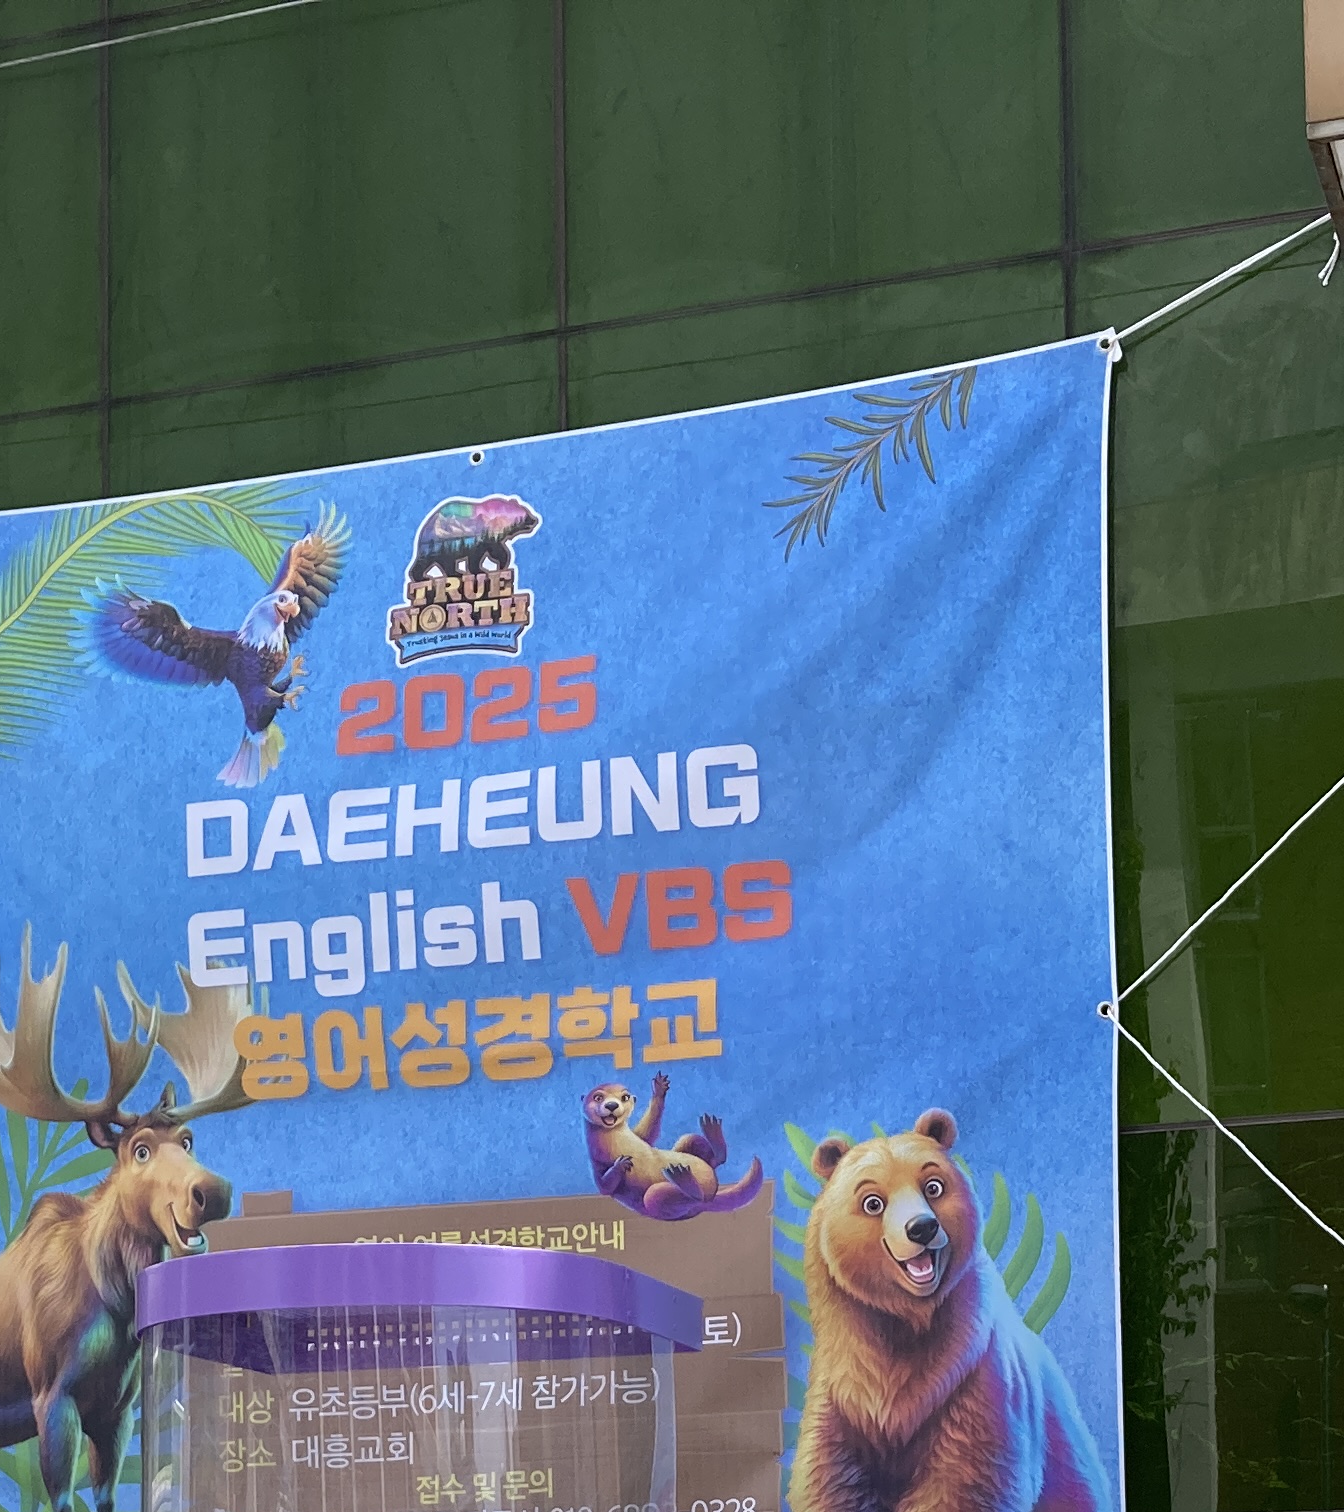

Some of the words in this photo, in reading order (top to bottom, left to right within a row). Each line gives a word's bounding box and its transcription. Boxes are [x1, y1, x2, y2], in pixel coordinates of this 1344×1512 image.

[392, 595, 529, 636] NORTH
[409, 571, 511, 606] TRUE
[336, 655, 597, 756] 2025
[185, 743, 760, 878] DAEHEUNG
[187, 881, 543, 998] English
[565, 860, 793, 956] VBS
[233, 978, 723, 1101] 영어성경학교
[219, 1389, 274, 1426] 대상
[531, 1367, 660, 1410] 참가가능)
[219, 1435, 277, 1473] 장소
[291, 1431, 415, 1470] 대흥교회
[416, 1474, 464, 1505] 접수
[474, 1472, 496, 1502] 및
[503, 1468, 554, 1499] 문의
